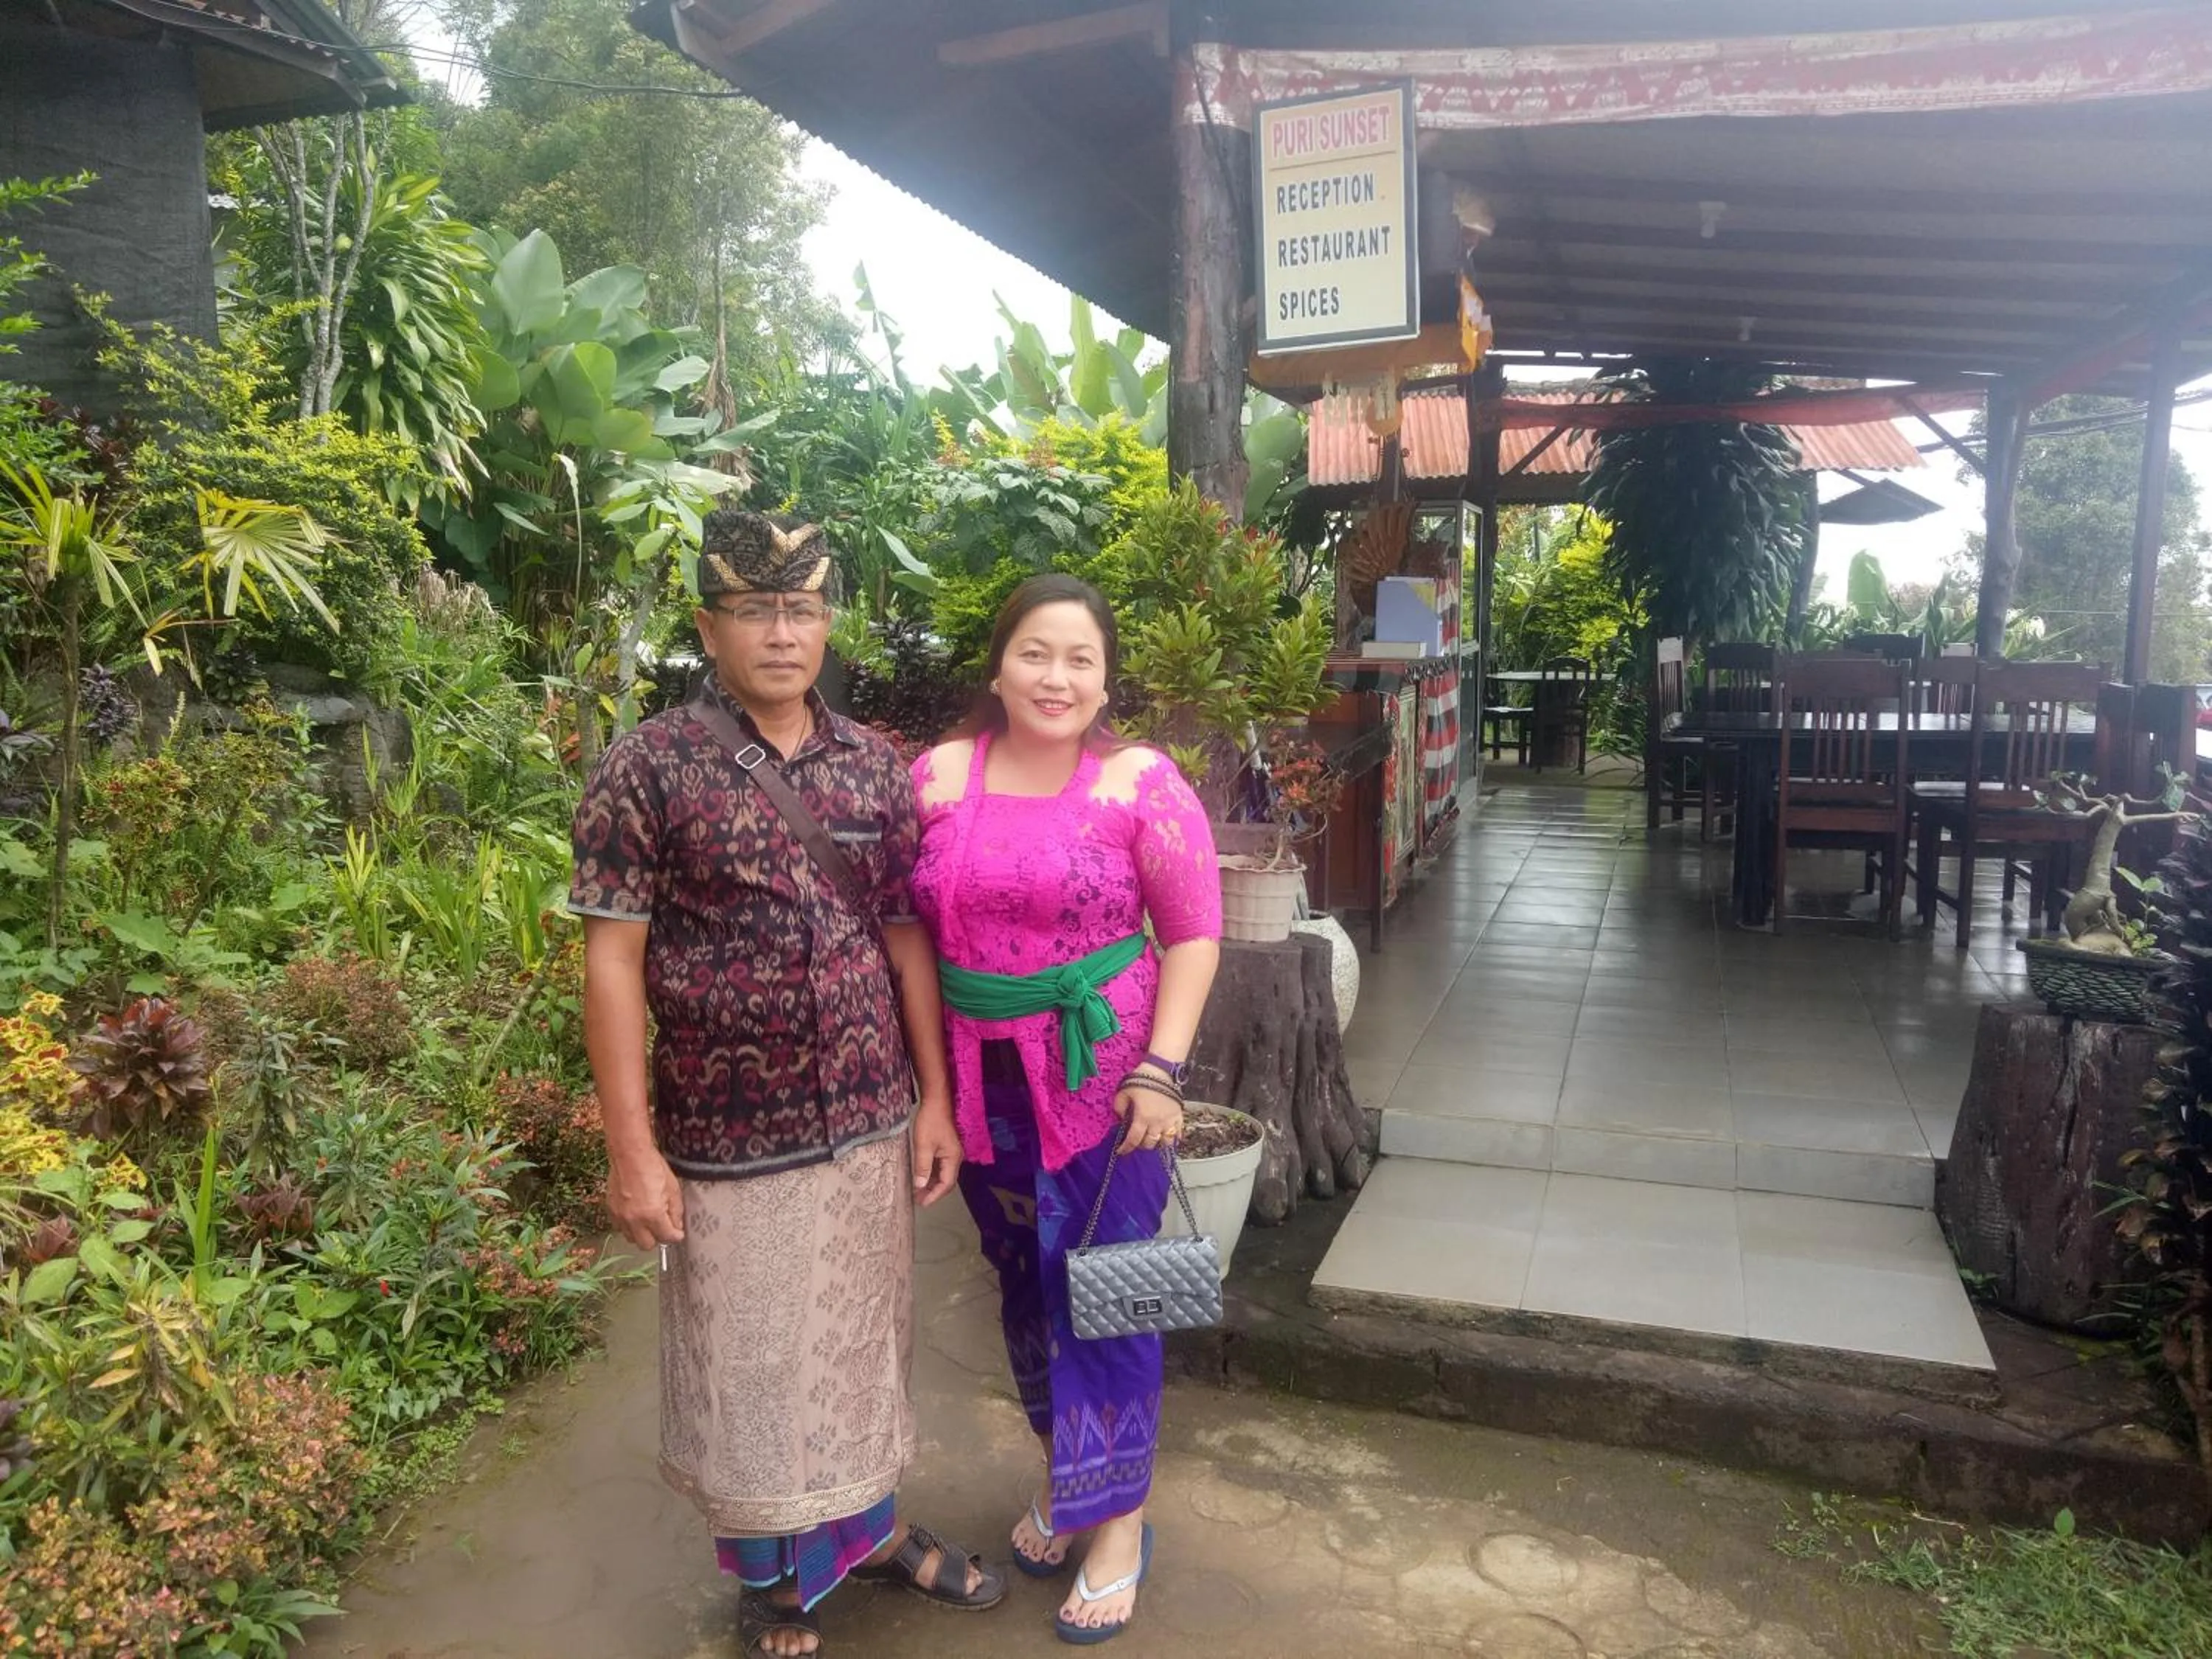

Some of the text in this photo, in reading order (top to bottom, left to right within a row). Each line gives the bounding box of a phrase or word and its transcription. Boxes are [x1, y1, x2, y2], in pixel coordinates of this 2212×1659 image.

[1273, 105, 1391, 158] PURI SUNSET
[1276, 173, 1374, 214] RECEPTION
[1278, 226, 1391, 268] RESTAURANT
[1279, 287, 1340, 321] SPICES
